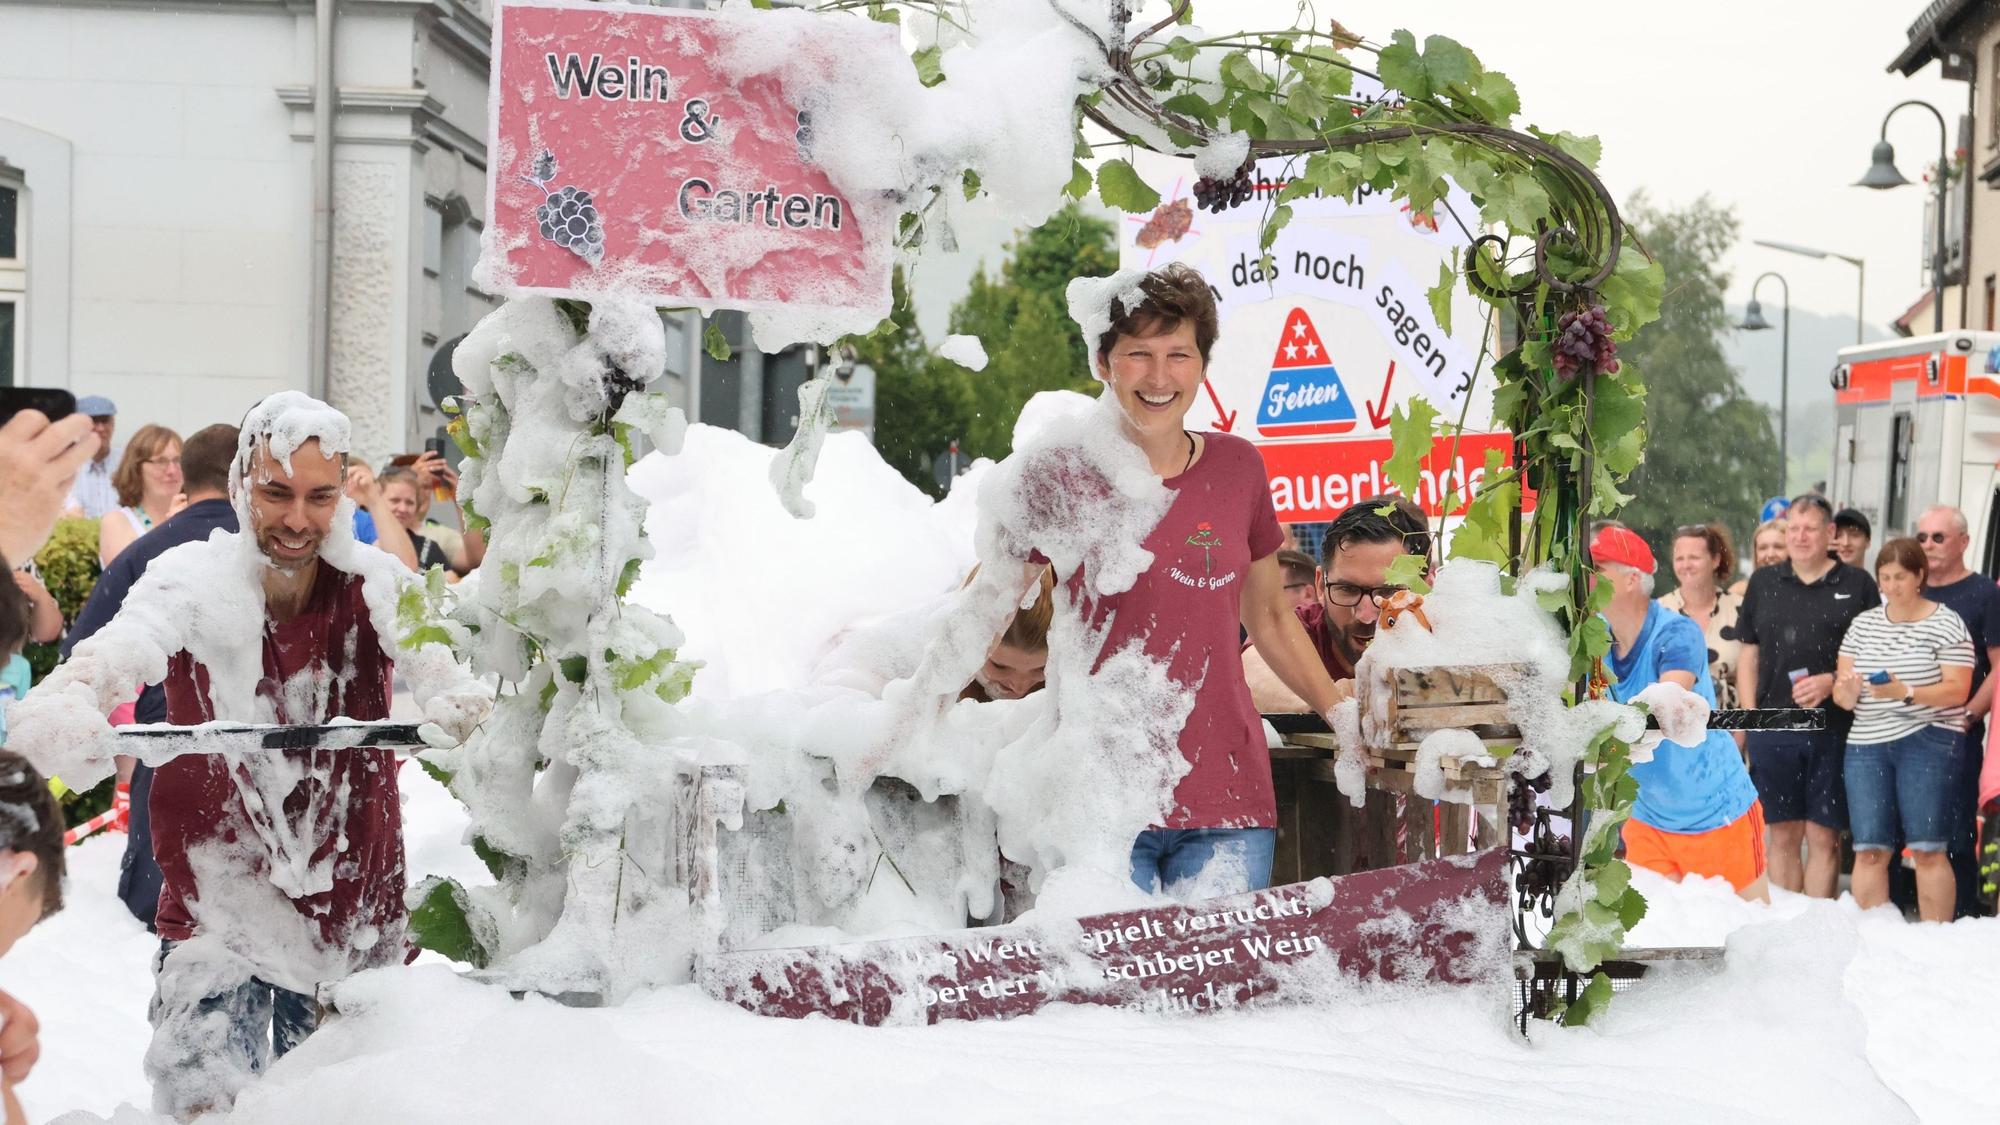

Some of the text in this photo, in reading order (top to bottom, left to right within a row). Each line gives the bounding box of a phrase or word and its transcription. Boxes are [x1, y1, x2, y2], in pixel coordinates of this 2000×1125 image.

[547, 53, 669, 101] Wein
[680, 99, 720, 143] &
[680, 179, 840, 229] Garten
[1232, 252, 1279, 287] das
[1294, 250, 1364, 290] noch
[1375, 284, 1447, 378] sagen
[1267, 380, 1340, 418] Fetten
[1171, 567, 1236, 591] Wein & Garten
[1081, 916, 1167, 954] spielt
[978, 975, 1029, 999] der
[1241, 930, 1321, 961] Wein
